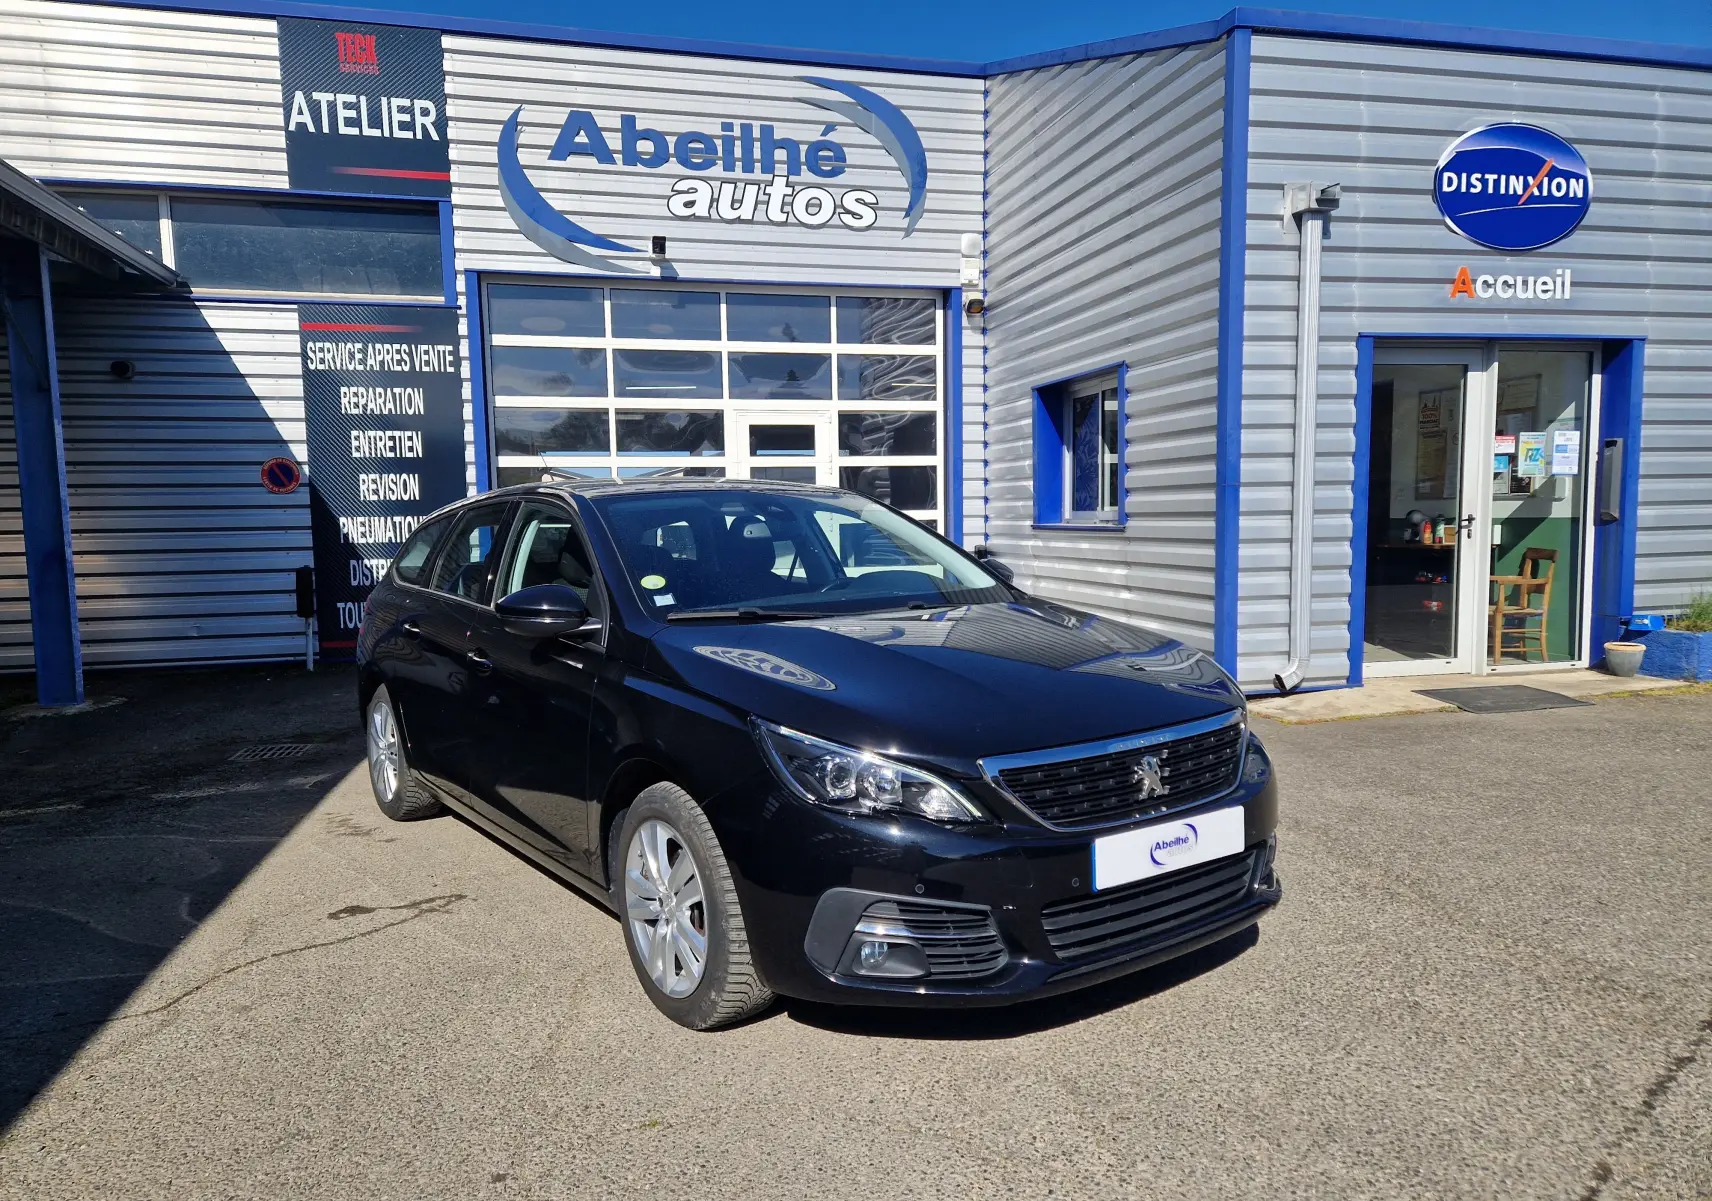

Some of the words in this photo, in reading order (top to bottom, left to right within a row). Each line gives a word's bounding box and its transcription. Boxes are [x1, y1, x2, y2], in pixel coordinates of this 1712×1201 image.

[335, 31, 377, 64] TECK
[288, 91, 440, 141] ATELIER
[547, 109, 847, 178] Abeilhé
[1442, 163, 1584, 202] DISTINXION
[666, 174, 879, 229] autos
[1449, 265, 1571, 299] Accueil
[307, 341, 364, 371] SERVICE
[366, 344, 410, 372] APRES
[412, 345, 455, 373] VENTE
[340, 386, 424, 416] REPARATION
[350, 430, 423, 458] ENTRETIEN
[359, 473, 420, 501] REVISION
[337, 601, 366, 629] TOU
